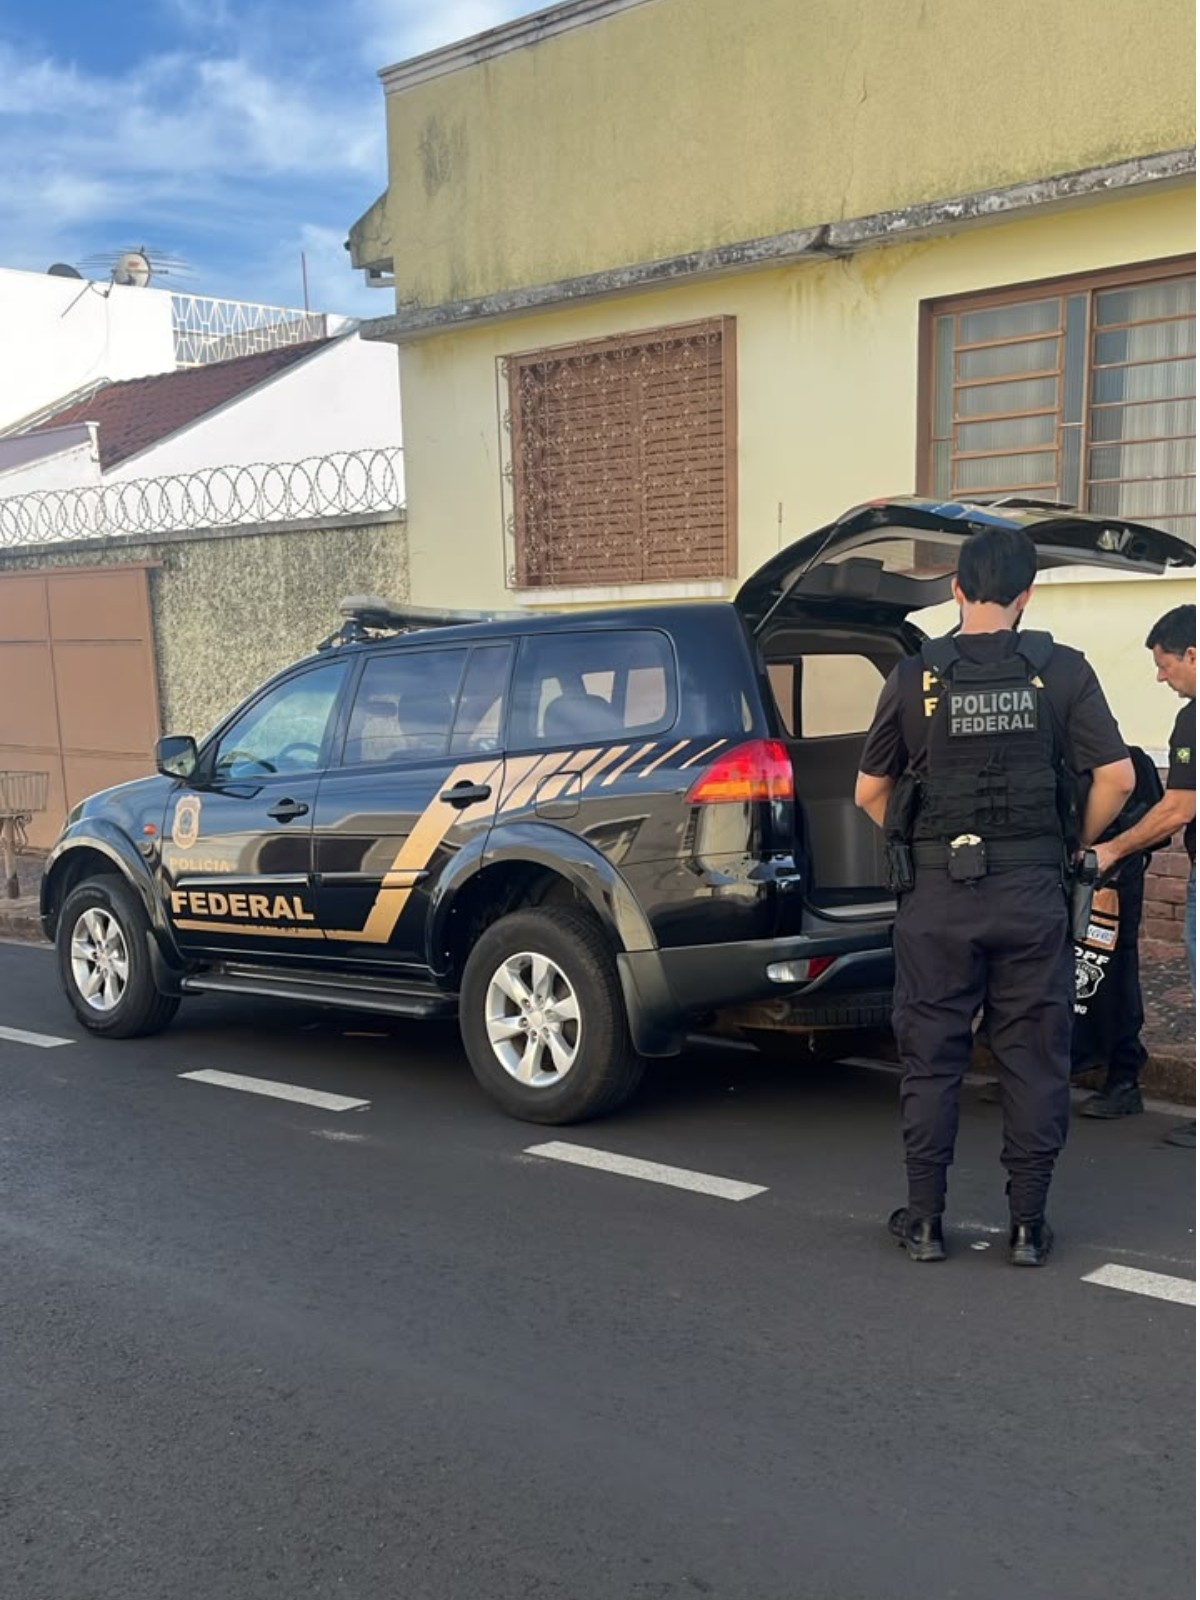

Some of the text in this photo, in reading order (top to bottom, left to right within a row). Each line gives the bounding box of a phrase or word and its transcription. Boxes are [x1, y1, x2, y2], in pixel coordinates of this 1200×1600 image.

[951, 690, 1034, 715] POLICIA
[951, 714, 1034, 734] FEDERAL
[170, 890, 315, 921] FEDERAL
